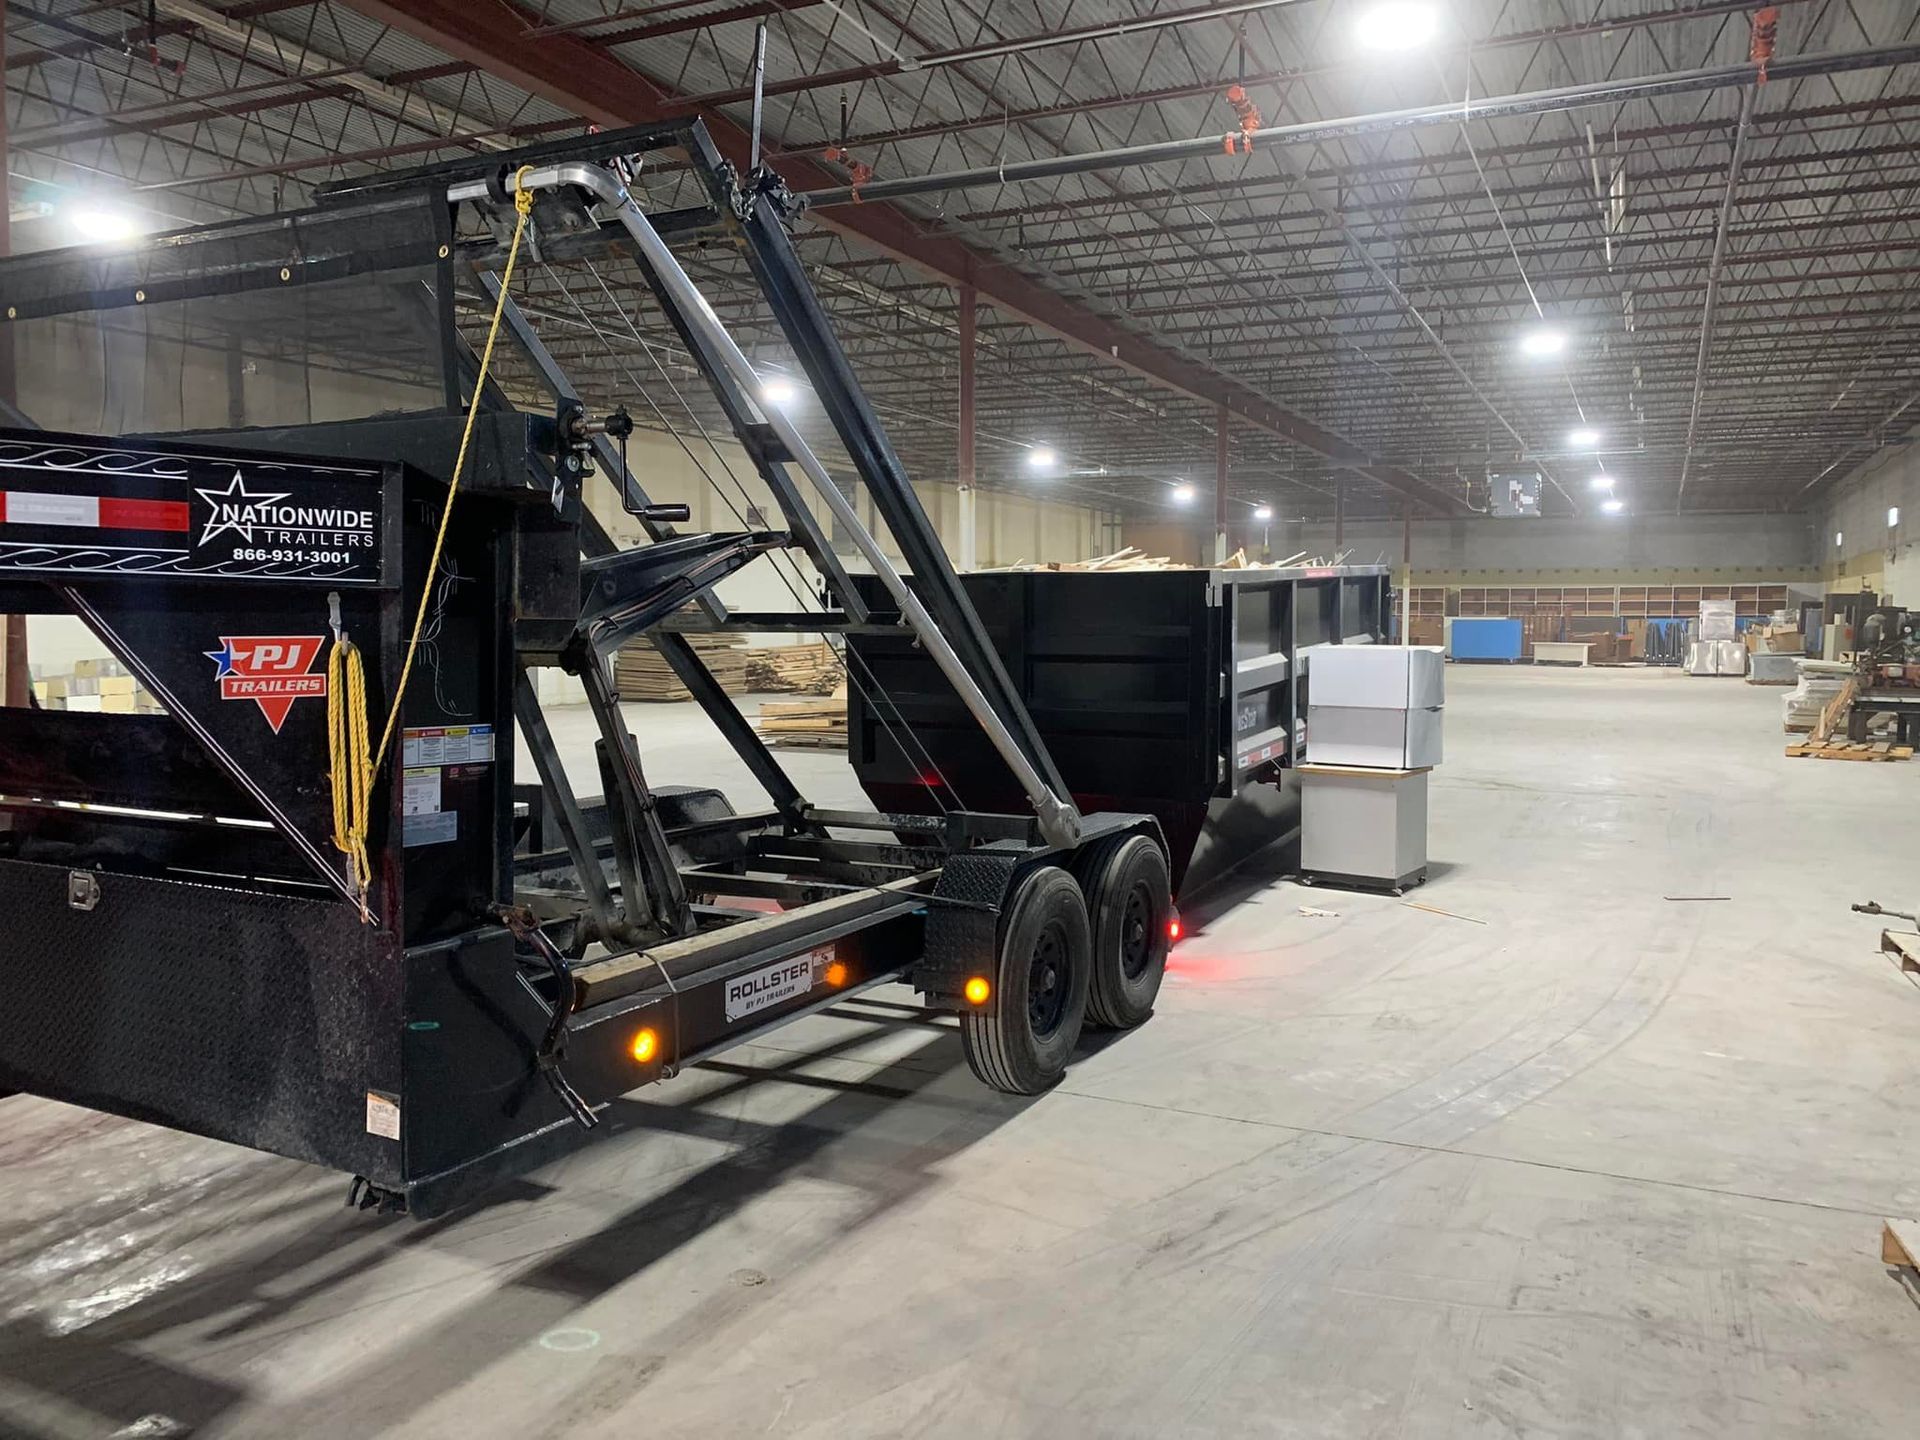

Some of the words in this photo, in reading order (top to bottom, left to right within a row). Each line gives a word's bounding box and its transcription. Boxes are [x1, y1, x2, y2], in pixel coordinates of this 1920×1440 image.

[222, 503, 373, 528] NATIONWIDE
[265, 531, 374, 547] TRAILERS
[233, 548, 350, 564] 866-931-3001
[250, 645, 301, 671] PJ
[230, 679, 320, 695] TRAILERS
[730, 962, 809, 1002] ROLLSTER
[746, 999, 755, 1010] BY
[756, 996, 765, 1006] PJ
[766, 985, 795, 1003] TRAILERS
